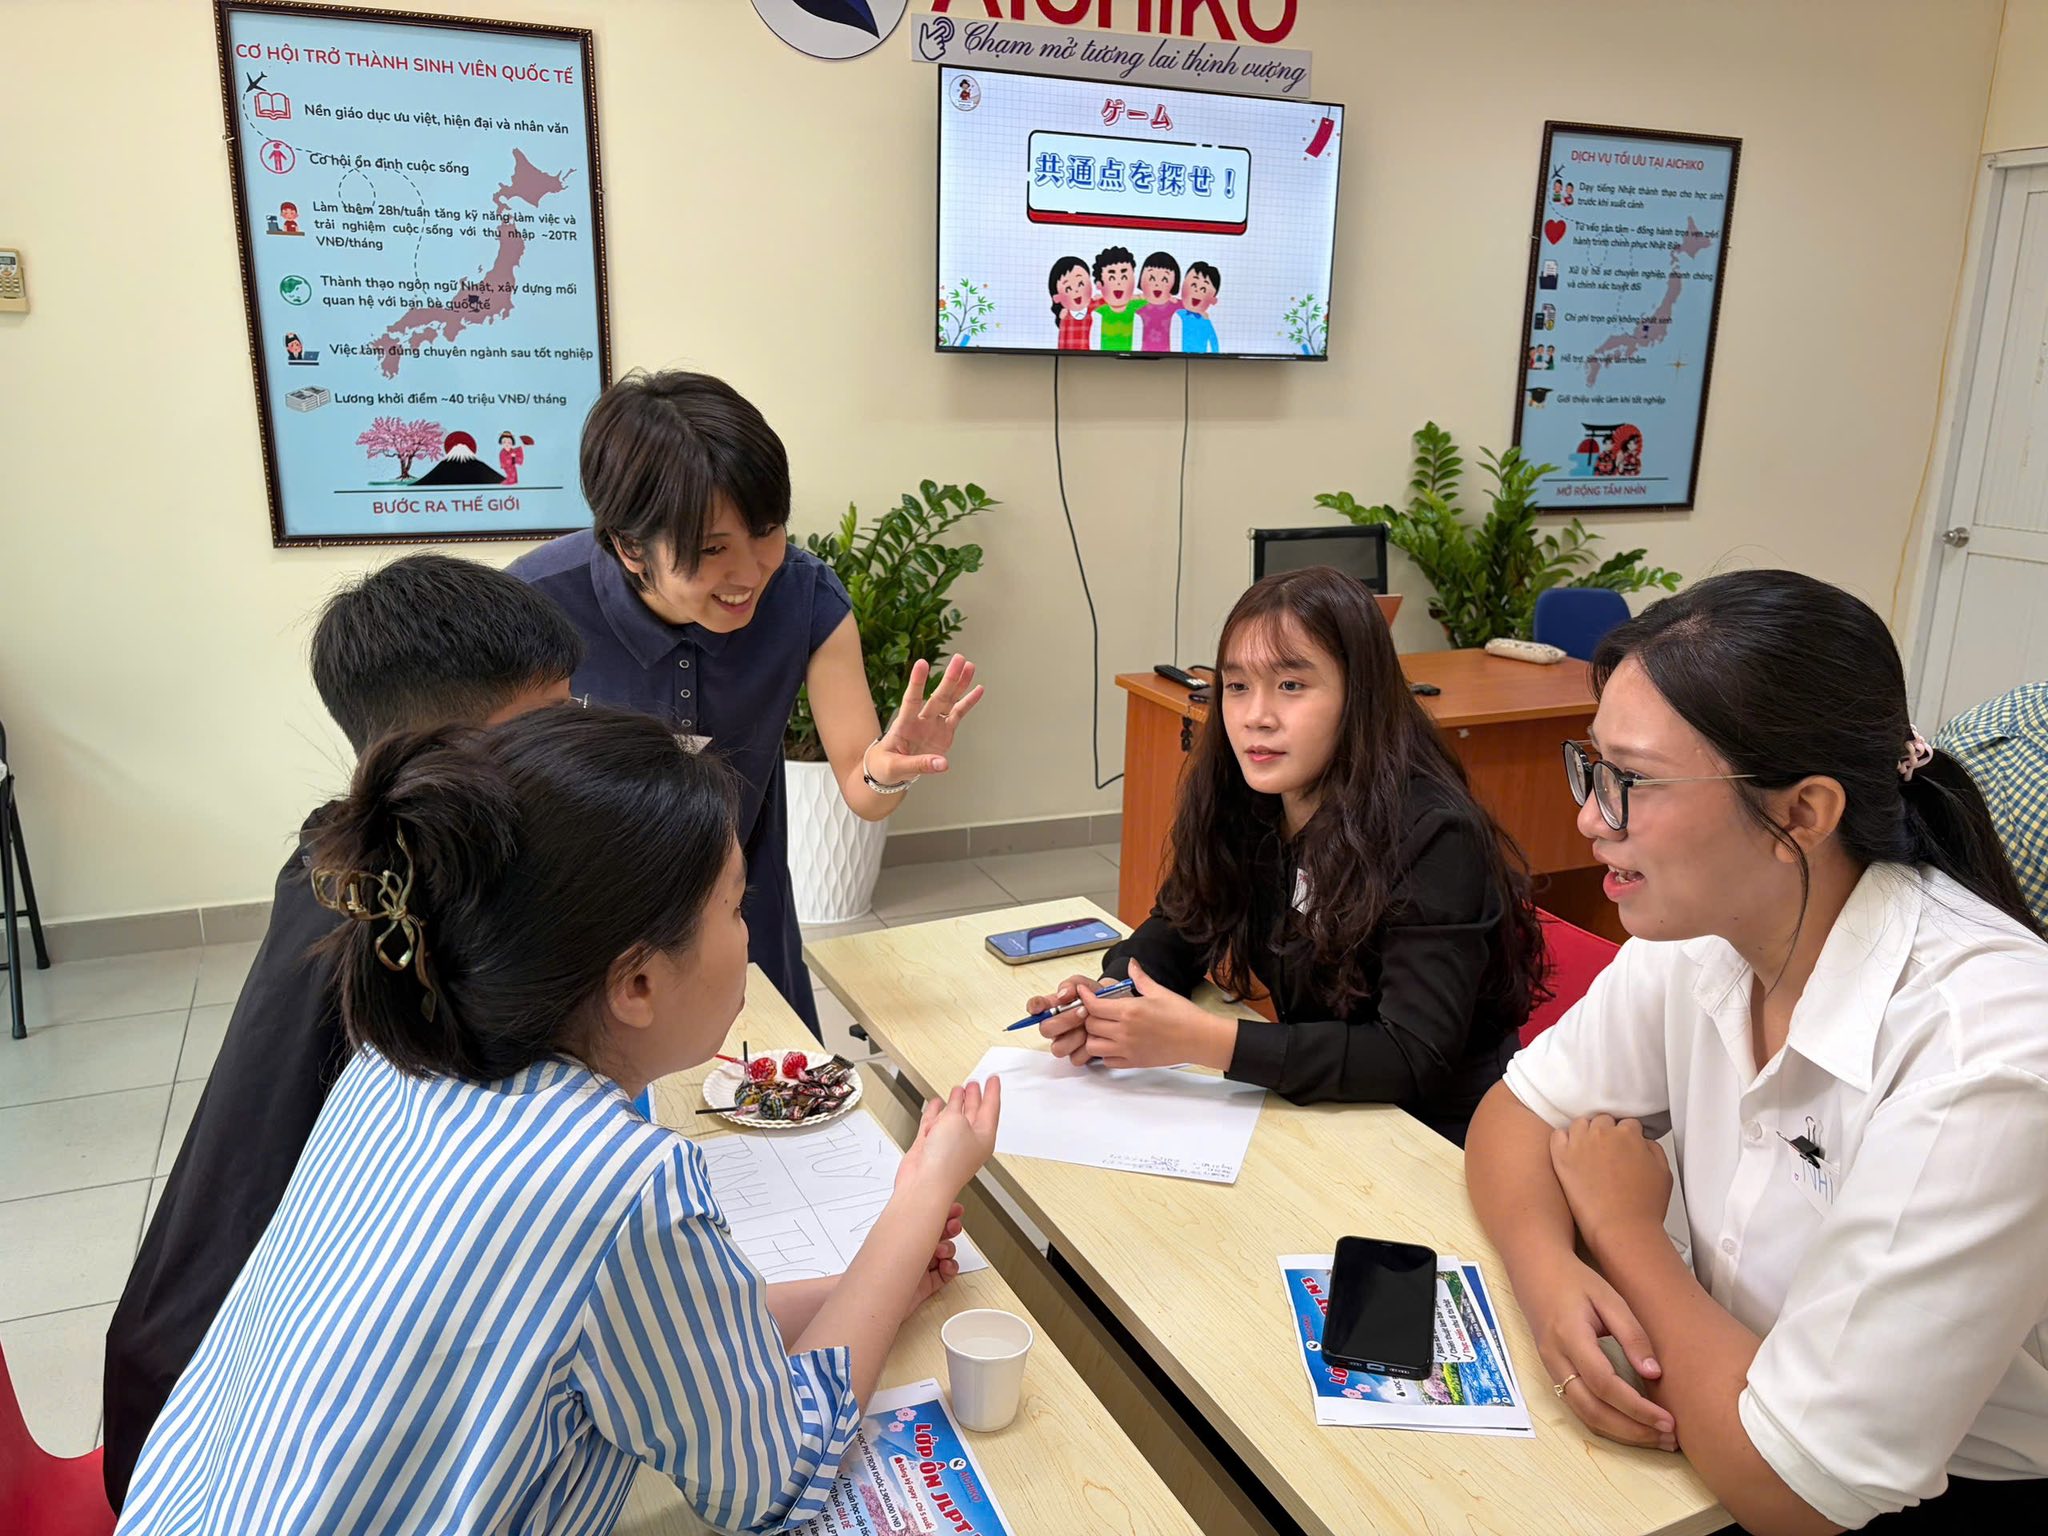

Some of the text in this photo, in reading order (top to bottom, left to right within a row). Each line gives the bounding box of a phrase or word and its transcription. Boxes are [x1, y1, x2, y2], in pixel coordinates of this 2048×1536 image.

[235, 43, 573, 85] CƠ HỘI TRỞ THÀNH SINH VIÊN QUỐC TẾ
[964, 22, 1306, 93] Chạm mở tương lai thịnh vượng
[304, 103, 568, 134] Nền giáo dục ưu việt, hiện đại và nhân văn
[1101, 99, 1173, 131] ゲーム
[406, 159, 436, 174] cuộc
[438, 160, 469, 176] sống
[312, 200, 338, 212] Làm
[340, 200, 375, 215] thêm
[377, 202, 430, 221] 28h/tuần
[433, 207, 460, 221] tăng
[464, 209, 478, 222] kỹ
[511, 211, 534, 225] làm
[538, 213, 560, 226] việc
[563, 214, 576, 224] và
[313, 218, 335, 229] trải
[341, 220, 385, 233] nghiệm
[422, 220, 453, 237] sống
[459, 225, 476, 236] với
[541, 229, 577, 241] ~20TR
[315, 235, 383, 251] VNĐ/tháng
[319, 274, 361, 287] Thành
[364, 276, 394, 291] thạo
[397, 277, 430, 294] ngôn
[433, 279, 459, 295] ngữ
[497, 278, 518, 296] xây
[521, 282, 551, 296] dựng
[555, 282, 576, 294] mối
[322, 296, 355, 307] quan
[358, 294, 374, 309] hệ
[377, 295, 396, 307] với
[423, 343, 466, 359] chuyên
[469, 346, 507, 359] ngành
[510, 349, 530, 357] sau
[533, 346, 551, 358] tốt
[553, 347, 593, 360] nghiệp
[334, 391, 567, 406] Lương khởi điểm ~40 triệu VNĐ/ tháng
[373, 496, 520, 515] BƯỚC RA THẾ GIỚI
[1301, 1277, 1323, 1295] N3
[915, 1424, 973, 1533] LỚP ÔN JLPT
[960, 1471, 982, 1503] AICHIKO
[843, 1481, 850, 1489] 10
[849, 1501, 861, 1515] học
[907, 1484, 916, 1499] ngay
